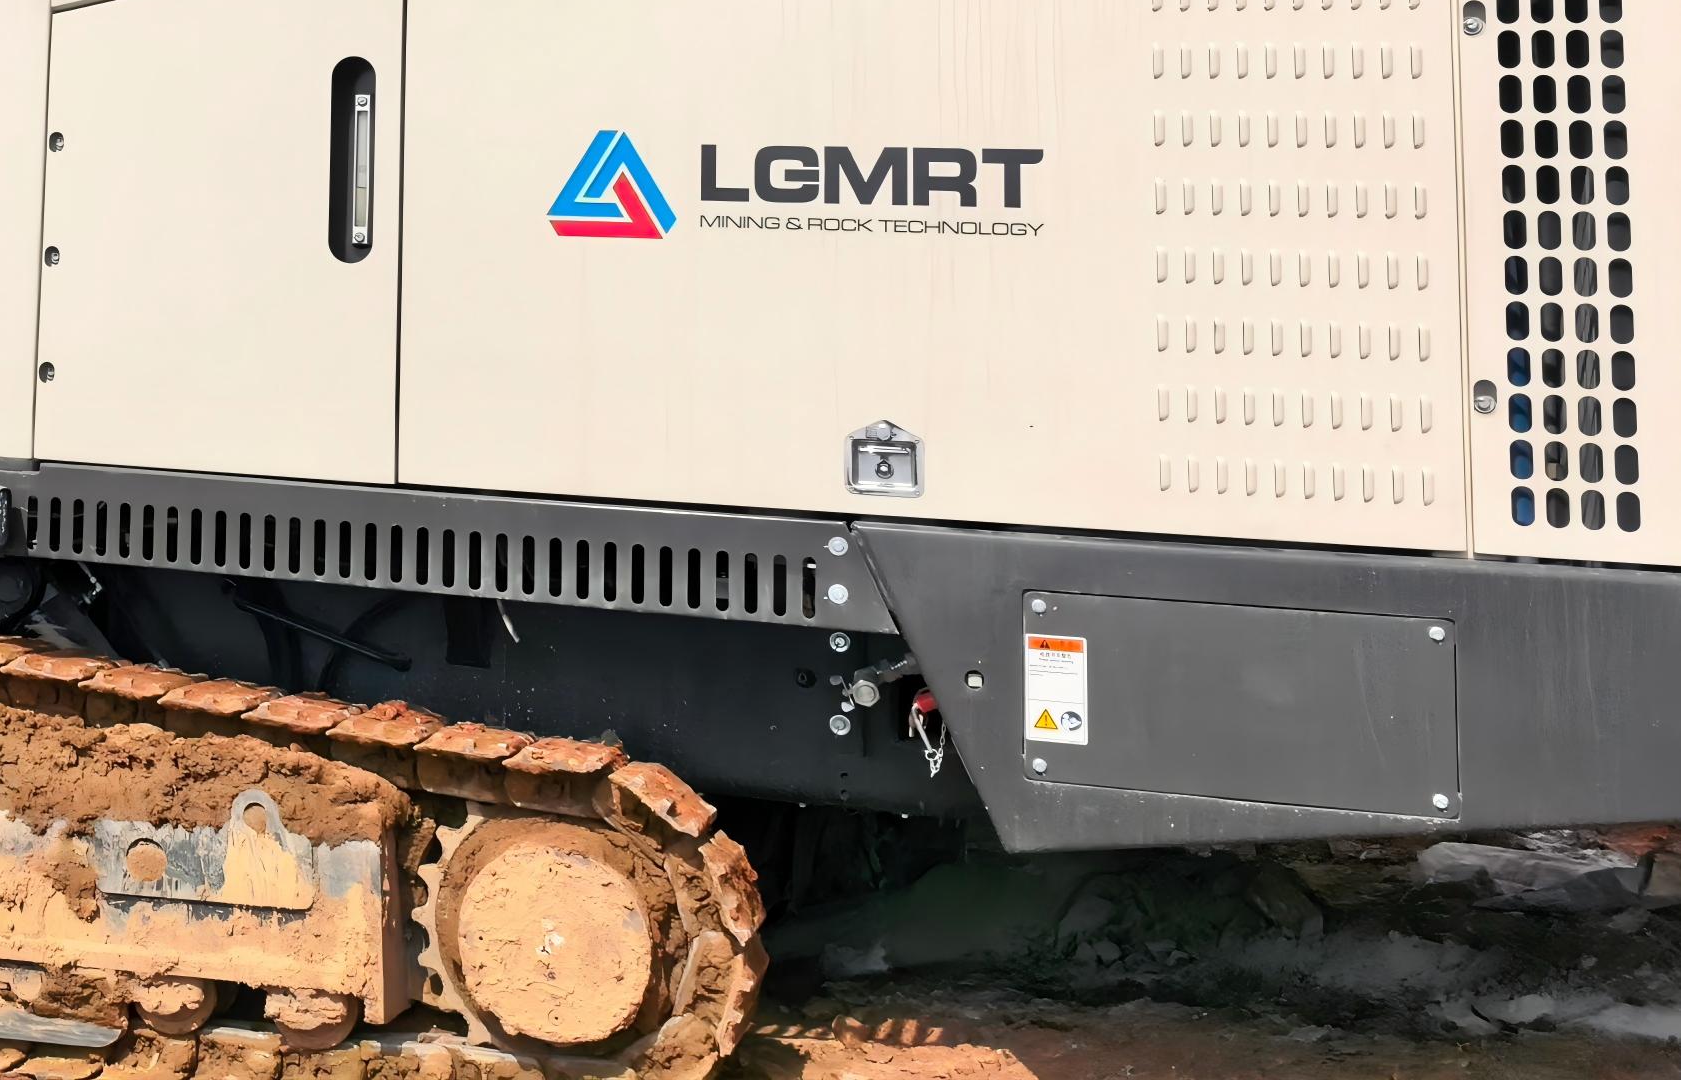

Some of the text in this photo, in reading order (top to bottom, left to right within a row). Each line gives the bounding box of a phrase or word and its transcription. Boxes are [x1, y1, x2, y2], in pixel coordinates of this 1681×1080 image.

[701, 144, 1044, 208] LGMRT
[700, 215, 1044, 236] MINING & ROCK TECHNOLOGY
